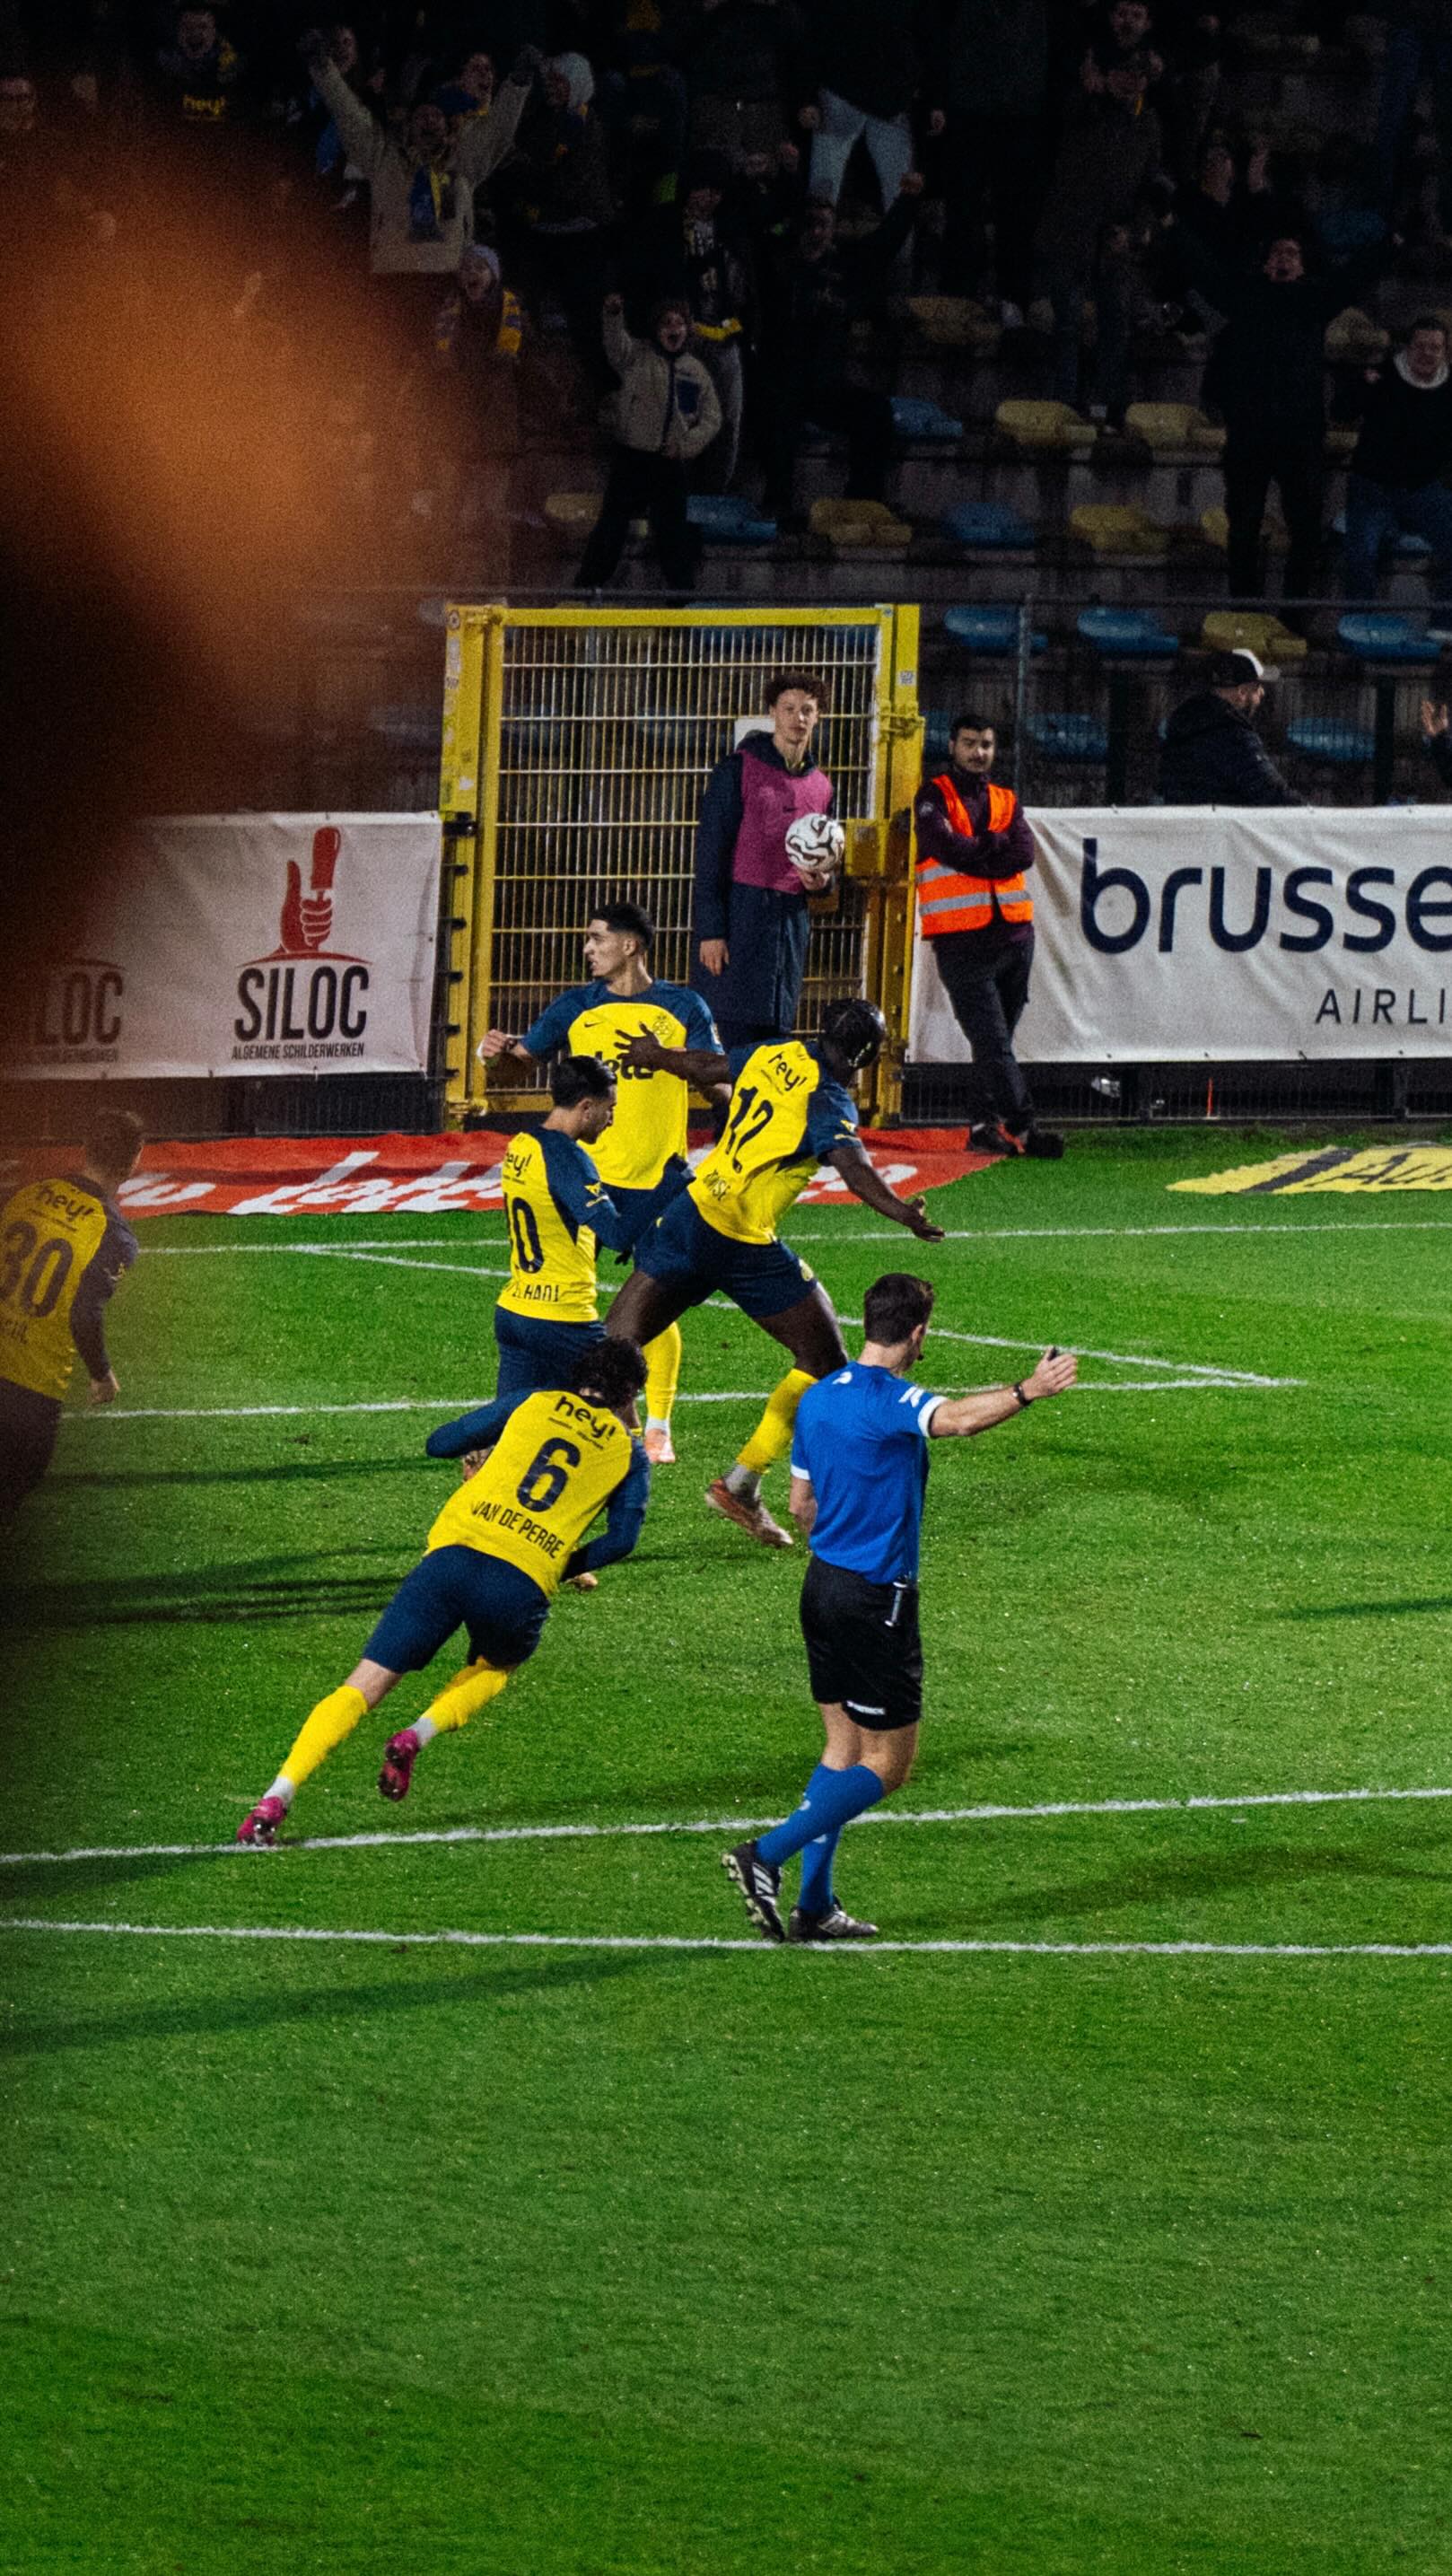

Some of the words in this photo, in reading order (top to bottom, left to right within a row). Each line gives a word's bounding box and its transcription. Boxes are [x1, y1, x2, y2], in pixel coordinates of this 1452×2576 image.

[1080, 837, 1452, 953] brusse
[233, 965, 370, 1042] SILOC
[1315, 988, 1446, 1024] AIRLI
[231, 1044, 281, 1060] ALGEMENE
[282, 1042, 365, 1058] SCHILDERWERKEN
[725, 1086, 774, 1174] 12
[555, 1396, 617, 1441] hey!
[516, 1437, 581, 1512] 6
[471, 1500, 502, 1523] VAN
[498, 1508, 523, 1530] DE
[518, 1518, 565, 1560] PERRE
